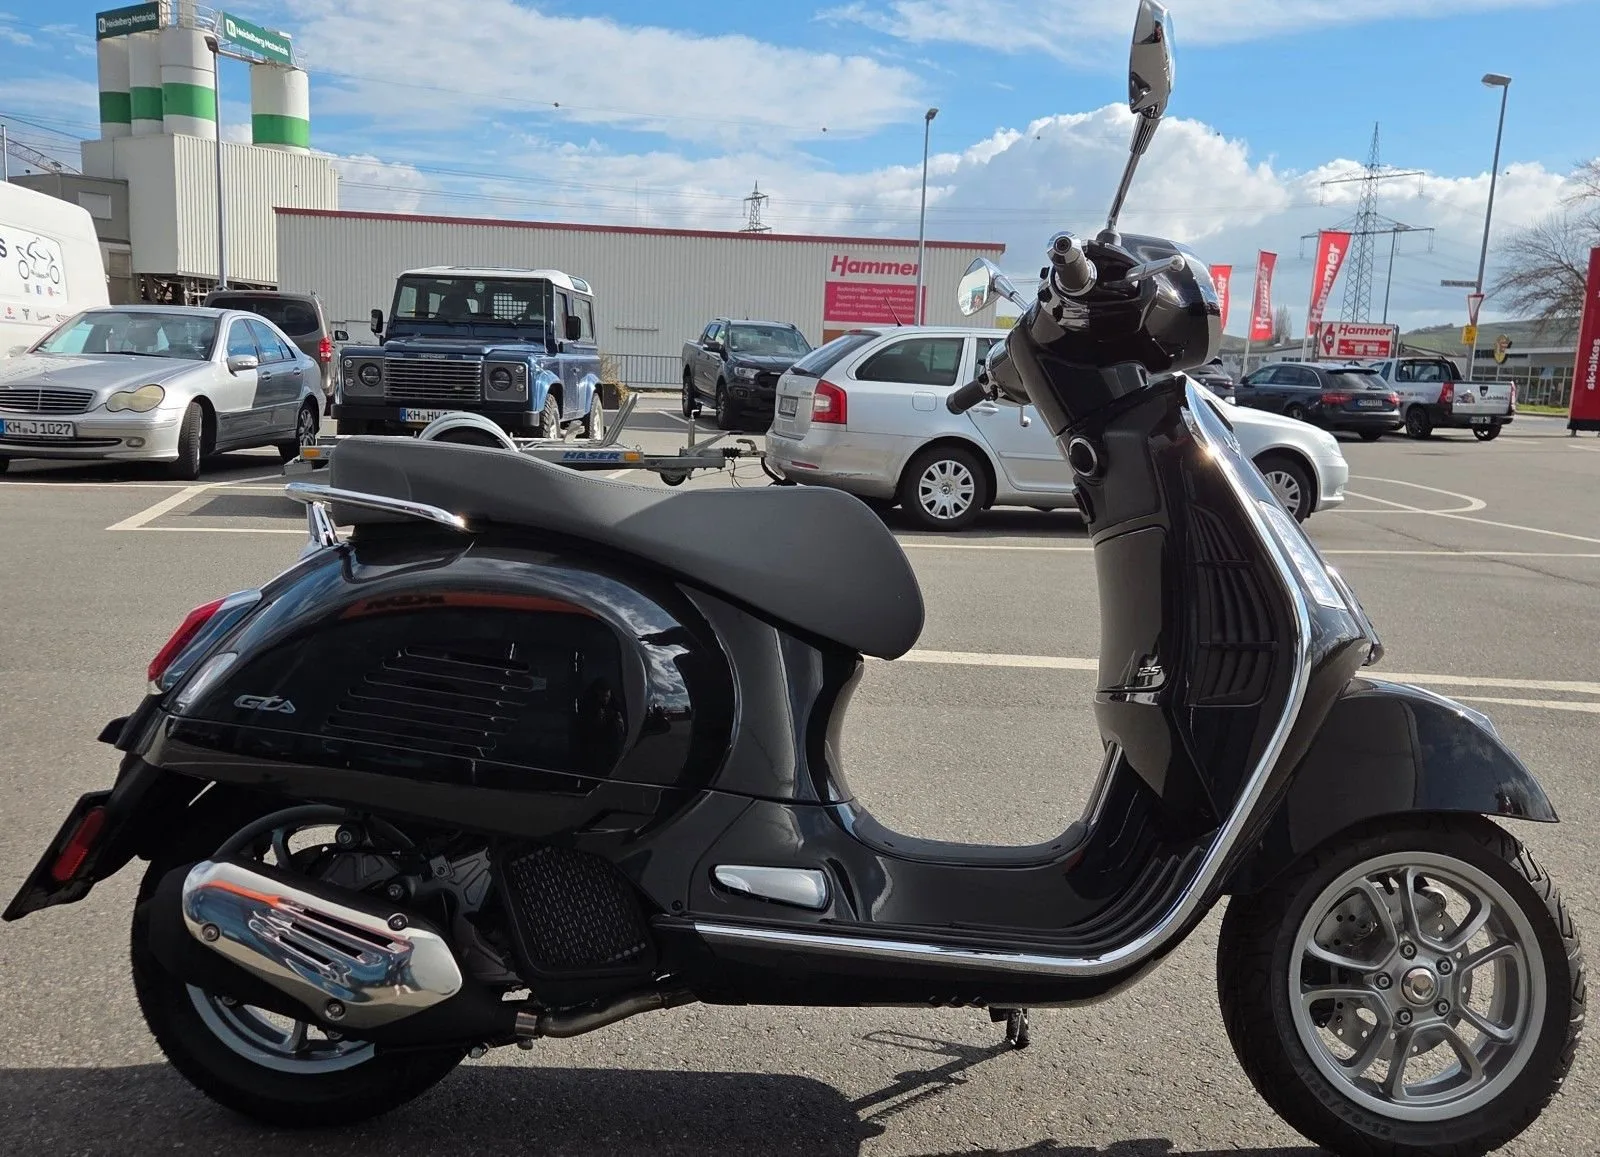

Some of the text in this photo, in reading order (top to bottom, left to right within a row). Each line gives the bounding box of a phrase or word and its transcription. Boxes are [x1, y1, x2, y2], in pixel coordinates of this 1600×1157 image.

[235, 27, 265, 48] Heidelberg
[831, 256, 919, 276] Hammer
[1310, 242, 1342, 324] Hammer
[1255, 263, 1272, 329] Hammer
[1338, 324, 1392, 336] Hammer
[406, 410, 420, 420] KH
[5, 421, 71, 435] KH J 1027
[563, 451, 620, 460] HASER
